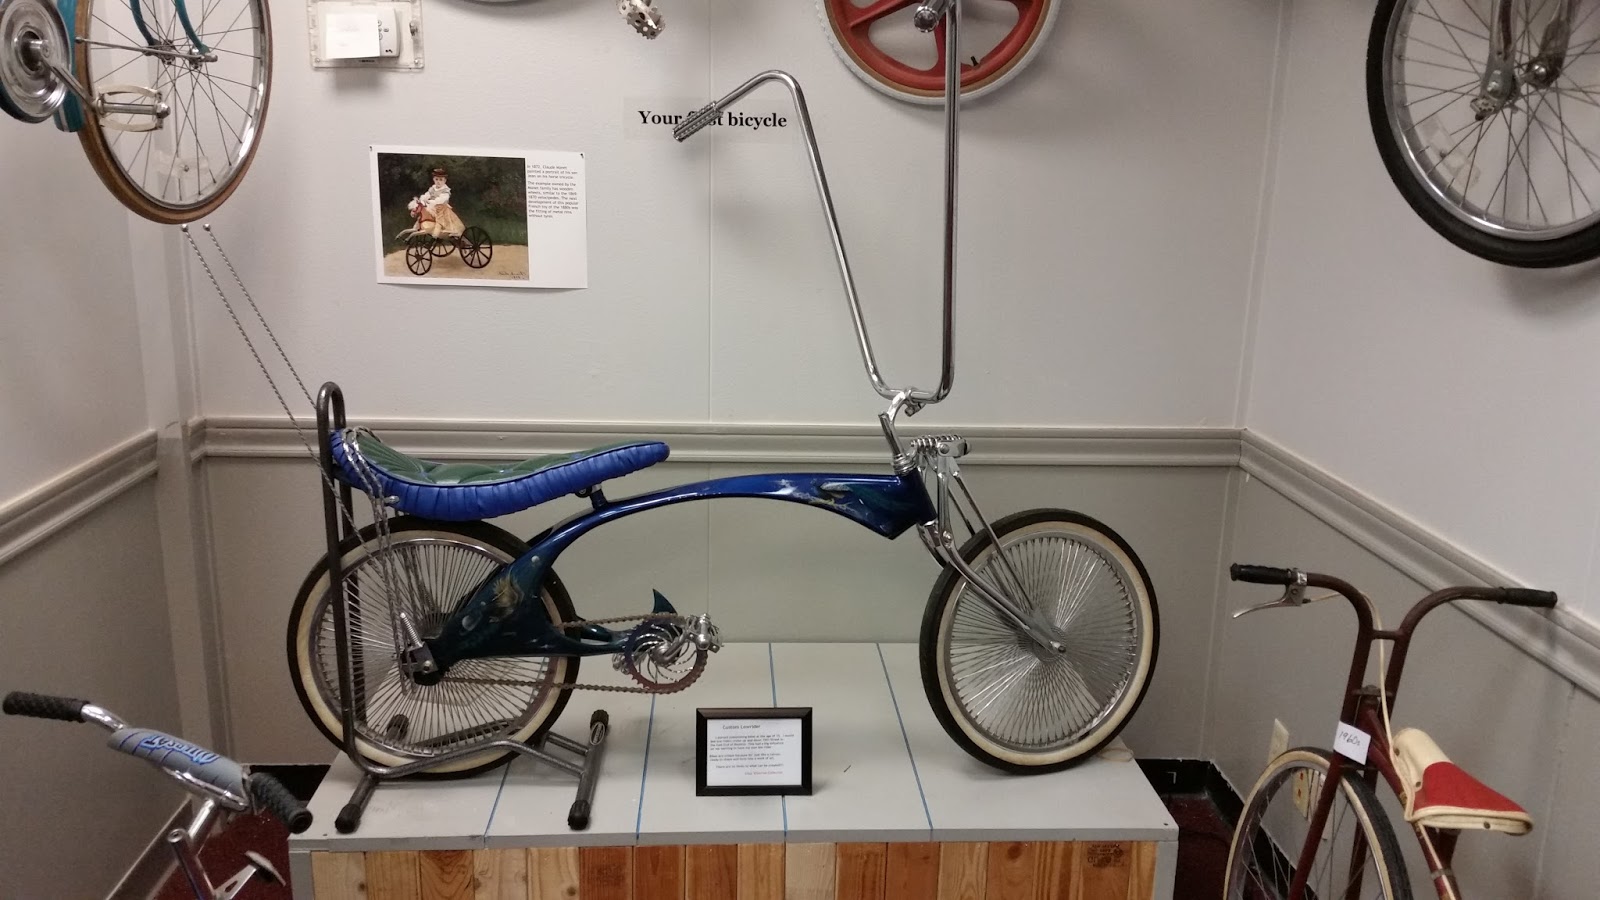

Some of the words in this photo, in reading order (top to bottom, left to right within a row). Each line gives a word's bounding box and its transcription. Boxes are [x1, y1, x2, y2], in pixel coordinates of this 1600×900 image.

[638, 110, 682, 124] Your
[686, 110, 724, 126] fst
[728, 112, 787, 130] bicycle
